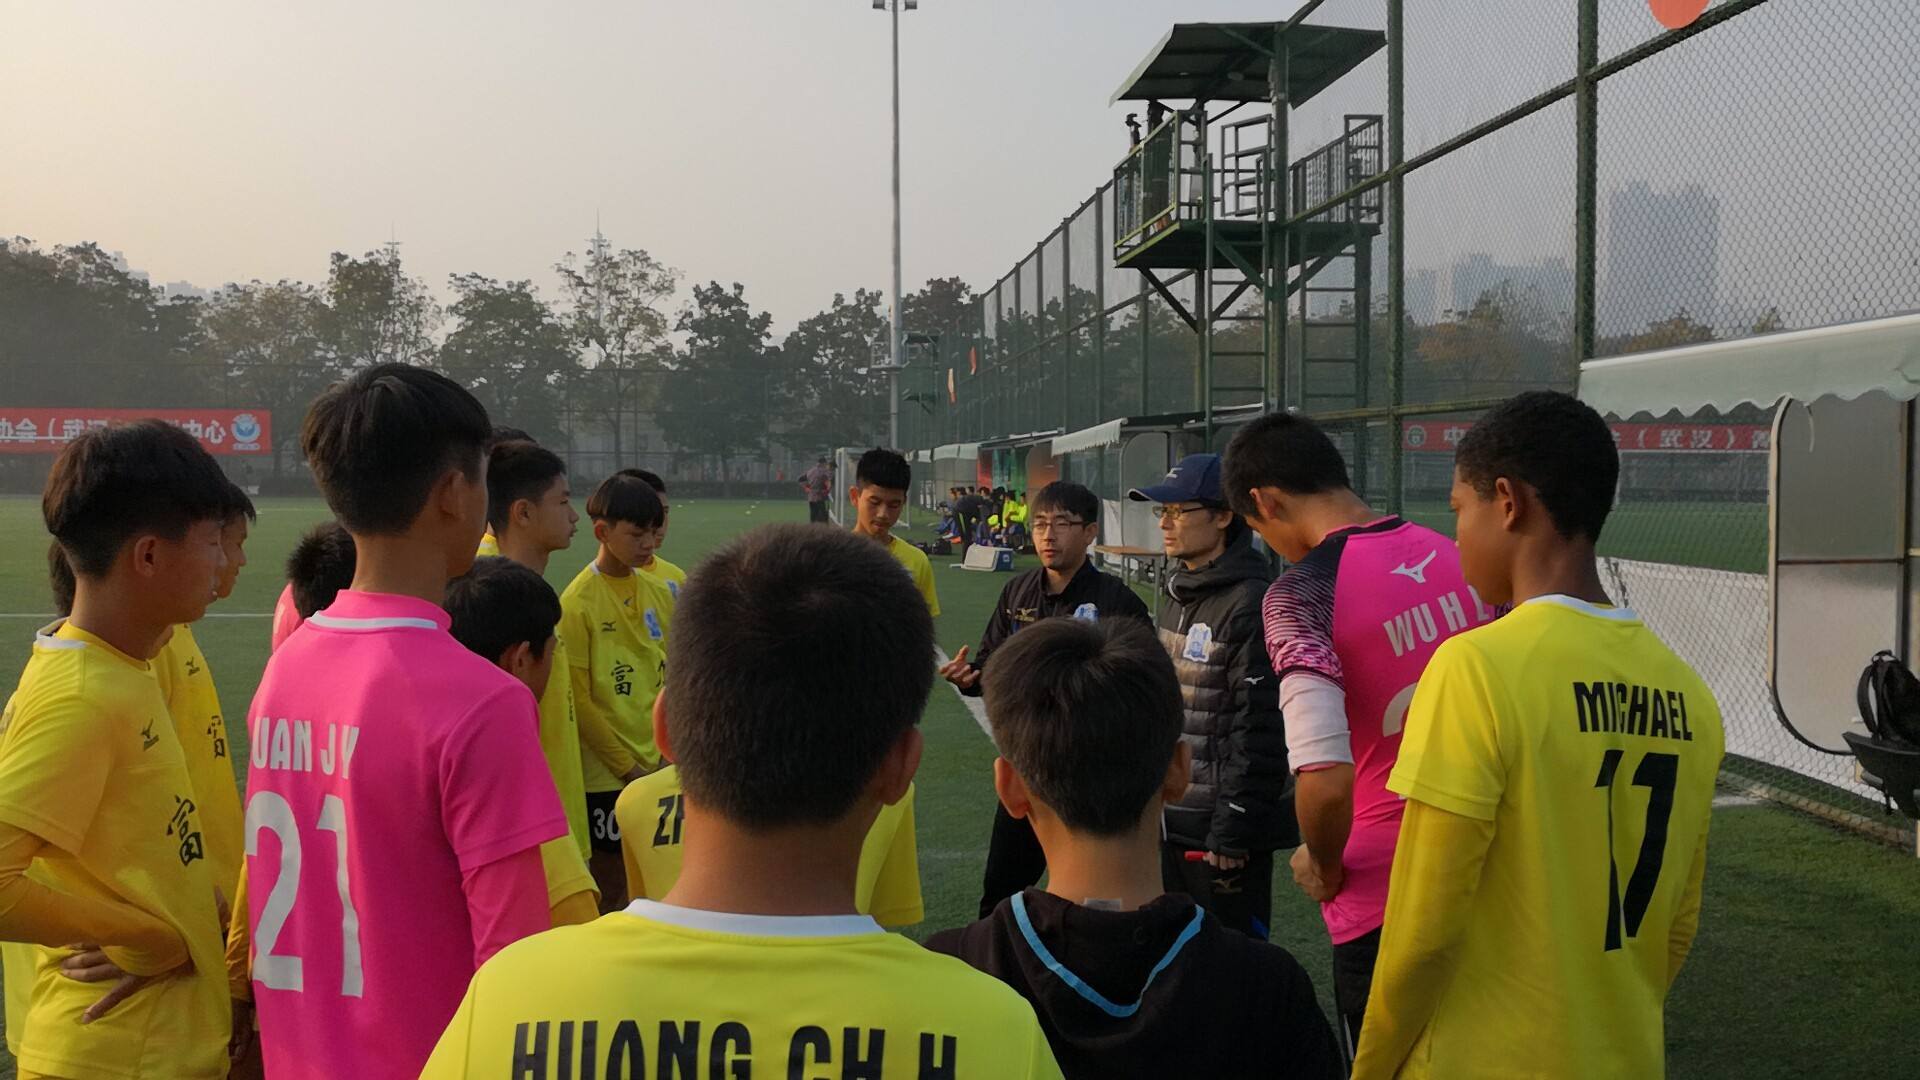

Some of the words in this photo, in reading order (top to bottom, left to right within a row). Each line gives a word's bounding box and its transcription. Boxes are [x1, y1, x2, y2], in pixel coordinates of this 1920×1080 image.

[1383, 603, 1438, 657] WU
[1437, 592, 1468, 632] H
[1573, 681, 1693, 741] MICHAEL
[320, 725, 360, 780] JY
[593, 808, 622, 841] 30
[245, 790, 364, 999] 21
[511, 1020, 752, 1080] HUANG
[788, 1026, 886, 1080] CH
